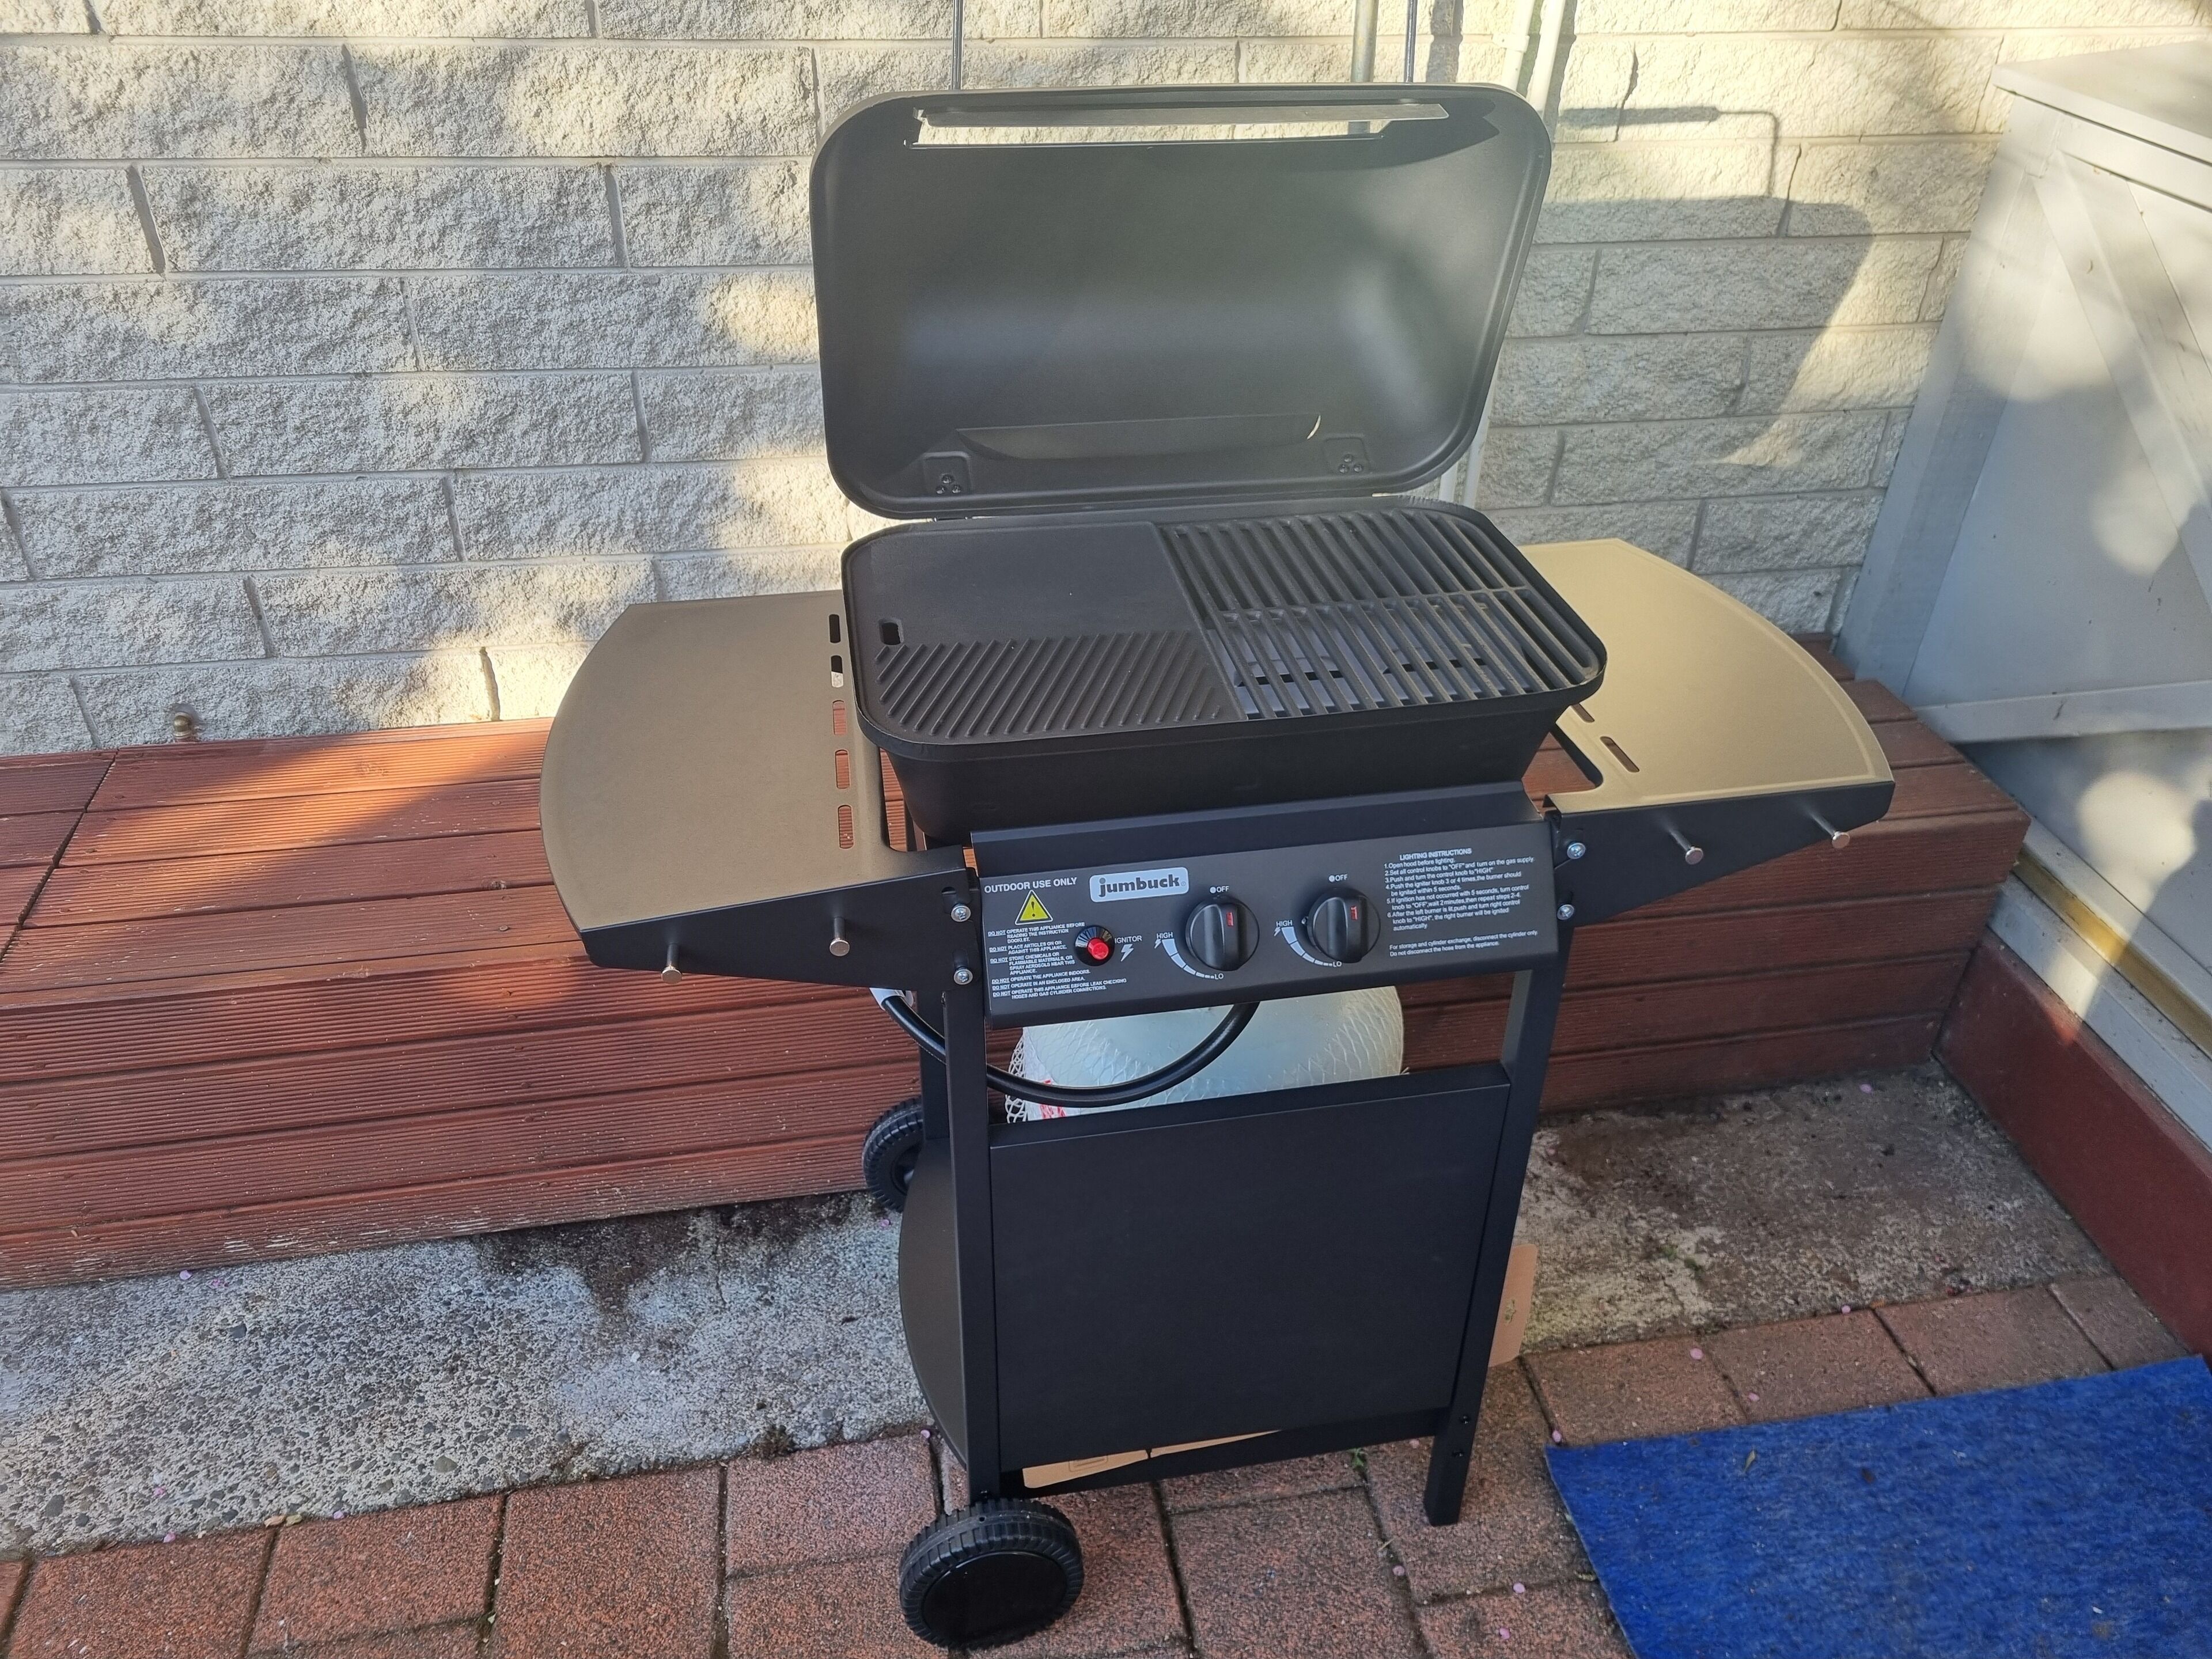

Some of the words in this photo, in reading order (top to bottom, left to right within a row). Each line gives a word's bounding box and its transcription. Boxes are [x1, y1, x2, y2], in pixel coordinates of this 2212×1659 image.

[1400, 853, 1427, 861] LIGHTING
[1428, 849, 1472, 857] INSTRUCTIONS
[984, 882, 1030, 893] OUTDOOR
[1033, 880, 1051, 889] USE
[1054, 877, 1077, 887] ONLY
[1098, 874, 1180, 897] jumbuck
[1115, 935, 1142, 944] IGNITOR
